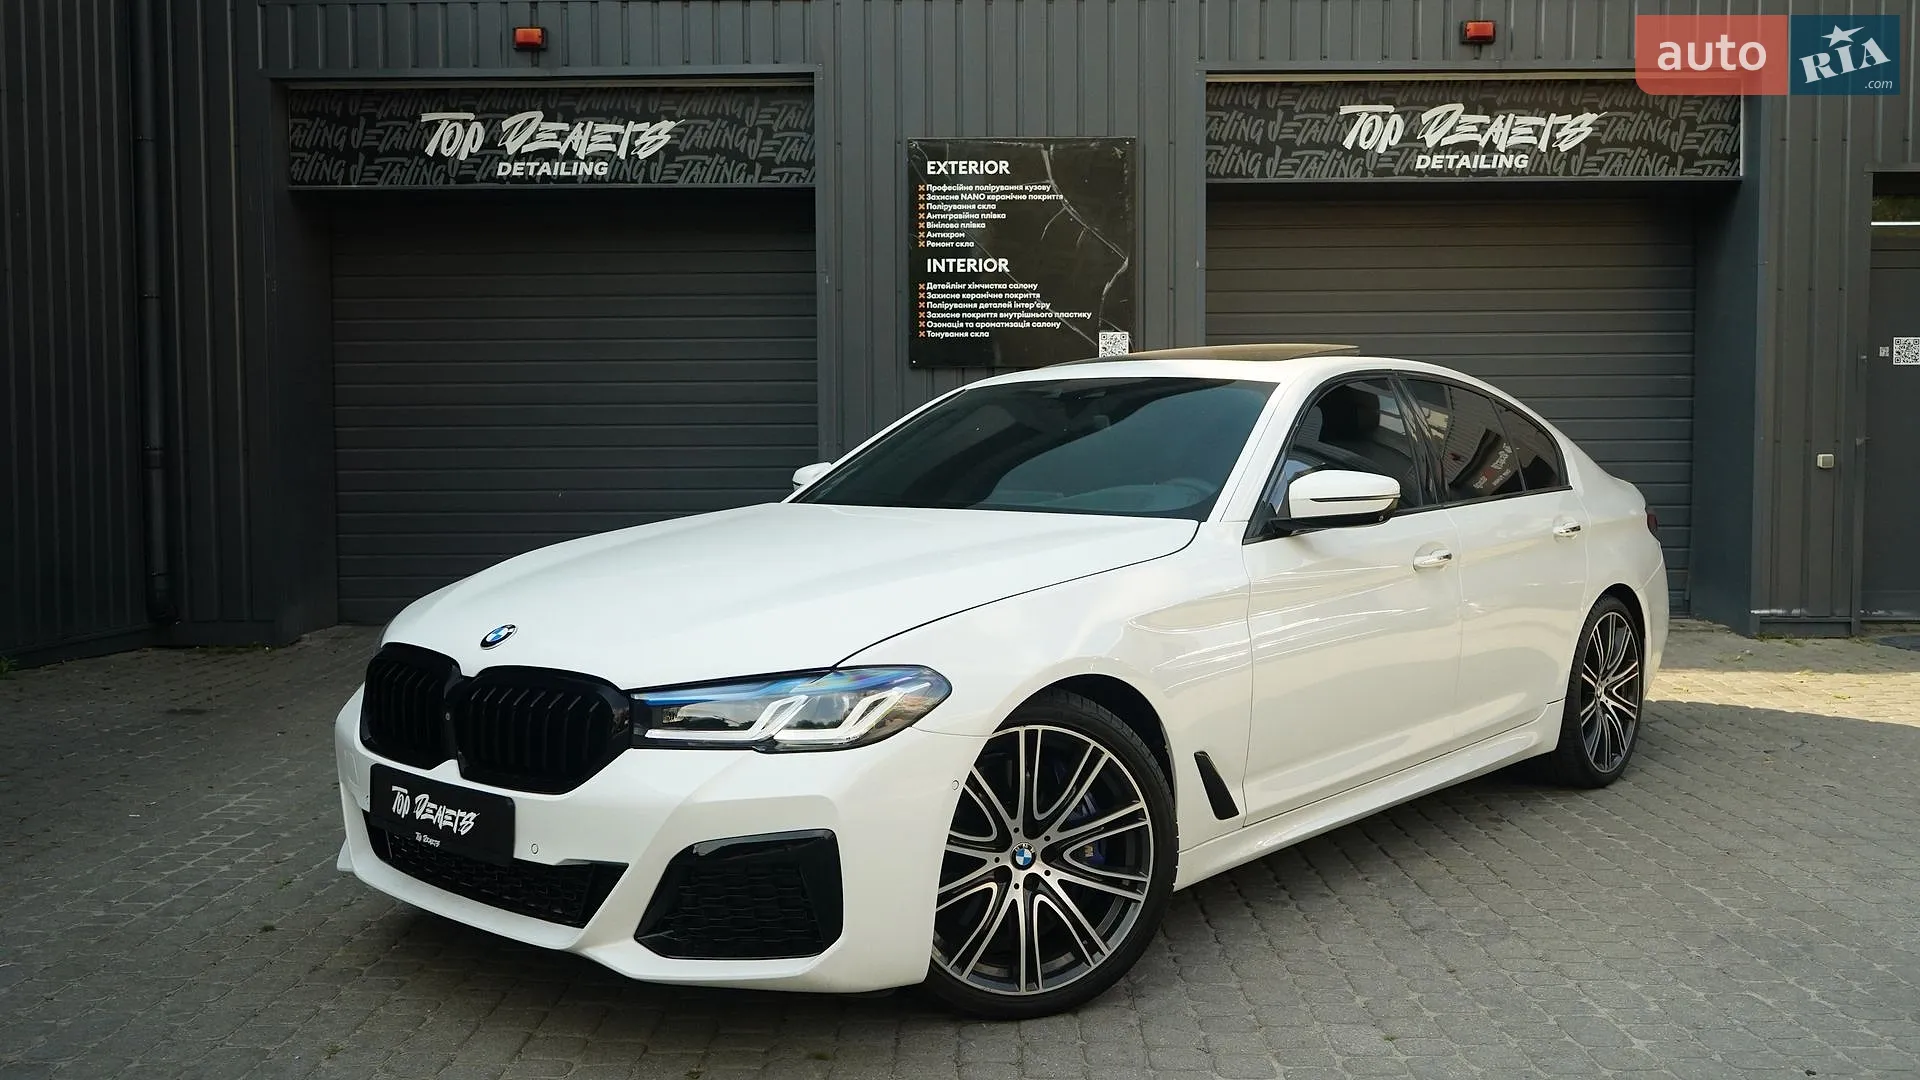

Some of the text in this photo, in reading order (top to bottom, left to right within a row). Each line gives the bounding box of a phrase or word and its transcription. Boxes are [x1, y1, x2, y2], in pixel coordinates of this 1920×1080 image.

[1415, 154, 1529, 169] DETAILING
[497, 161, 609, 176] DETAILING
[926, 160, 1011, 175] EXTERIOR
[926, 183, 1052, 193] Професійне полірування кузову
[926, 193, 960, 201] Захисне
[986, 192, 1028, 202] керамічне
[1028, 194, 1064, 202] покриття
[926, 202, 976, 211] Полірування
[926, 211, 1006, 220] Антигравійна плівка
[926, 220, 986, 229] Вінілова плівка
[926, 231, 966, 239] Антихром
[927, 258, 1010, 273] INTERIOR
[926, 282, 967, 290] Детейлінг
[1008, 282, 1038, 290] салону
[962, 291, 1004, 300] керамічне
[1004, 292, 1041, 301] покриття
[926, 301, 978, 310] Полірування
[979, 301, 1013, 309] деталей
[962, 312, 998, 320] покриття
[999, 310, 1054, 320] внутрішнього
[1054, 312, 1092, 320] пластику
[975, 320, 1031, 329] ароматизація
[926, 330, 969, 339] Тонування
